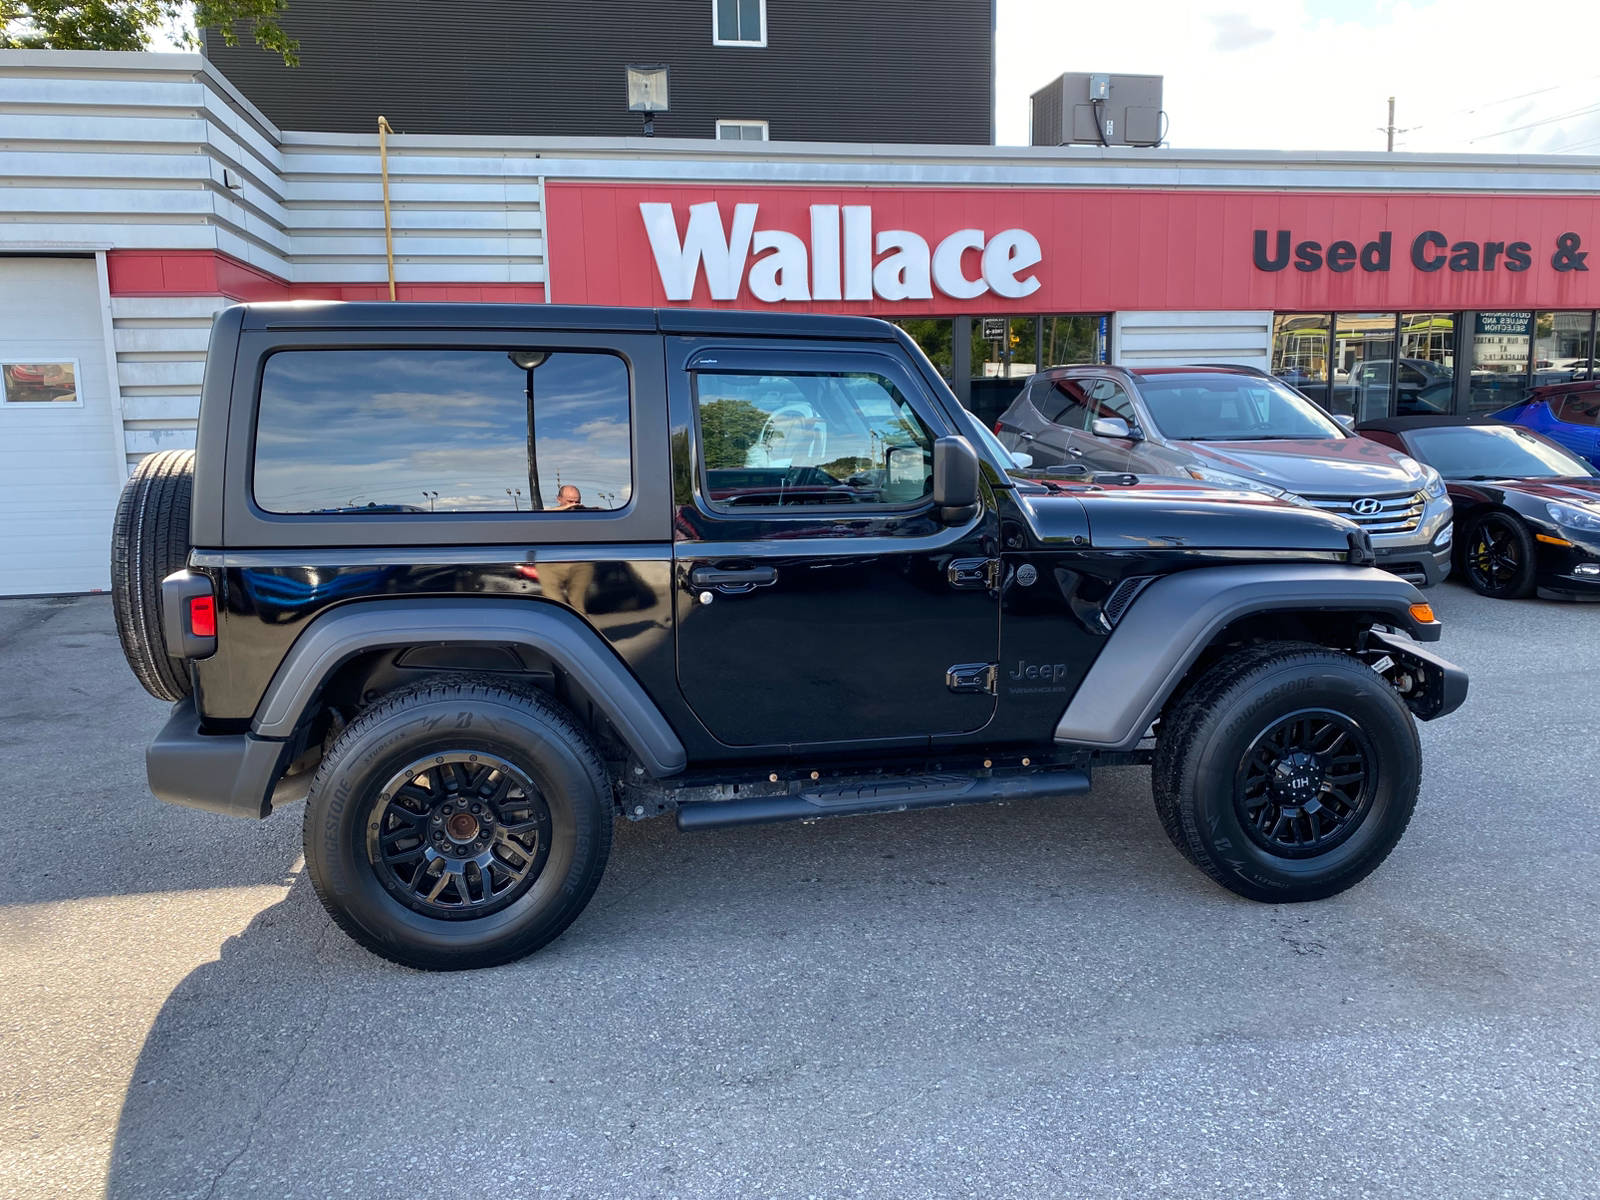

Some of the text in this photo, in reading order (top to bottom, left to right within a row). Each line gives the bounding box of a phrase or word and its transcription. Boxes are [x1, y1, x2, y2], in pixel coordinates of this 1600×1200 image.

[639, 201, 1043, 303] Wallace
[1253, 230, 1589, 272] Used Cars &
[1009, 660, 1068, 683] Jeep
[1009, 686, 1067, 694] WRANGLER
[1224, 676, 1315, 736] BRIDGESTONE
[363, 731, 407, 765] STUDLESS
[324, 777, 353, 896] BRIDGESTONE
[1253, 873, 1291, 889] STUDLESS
